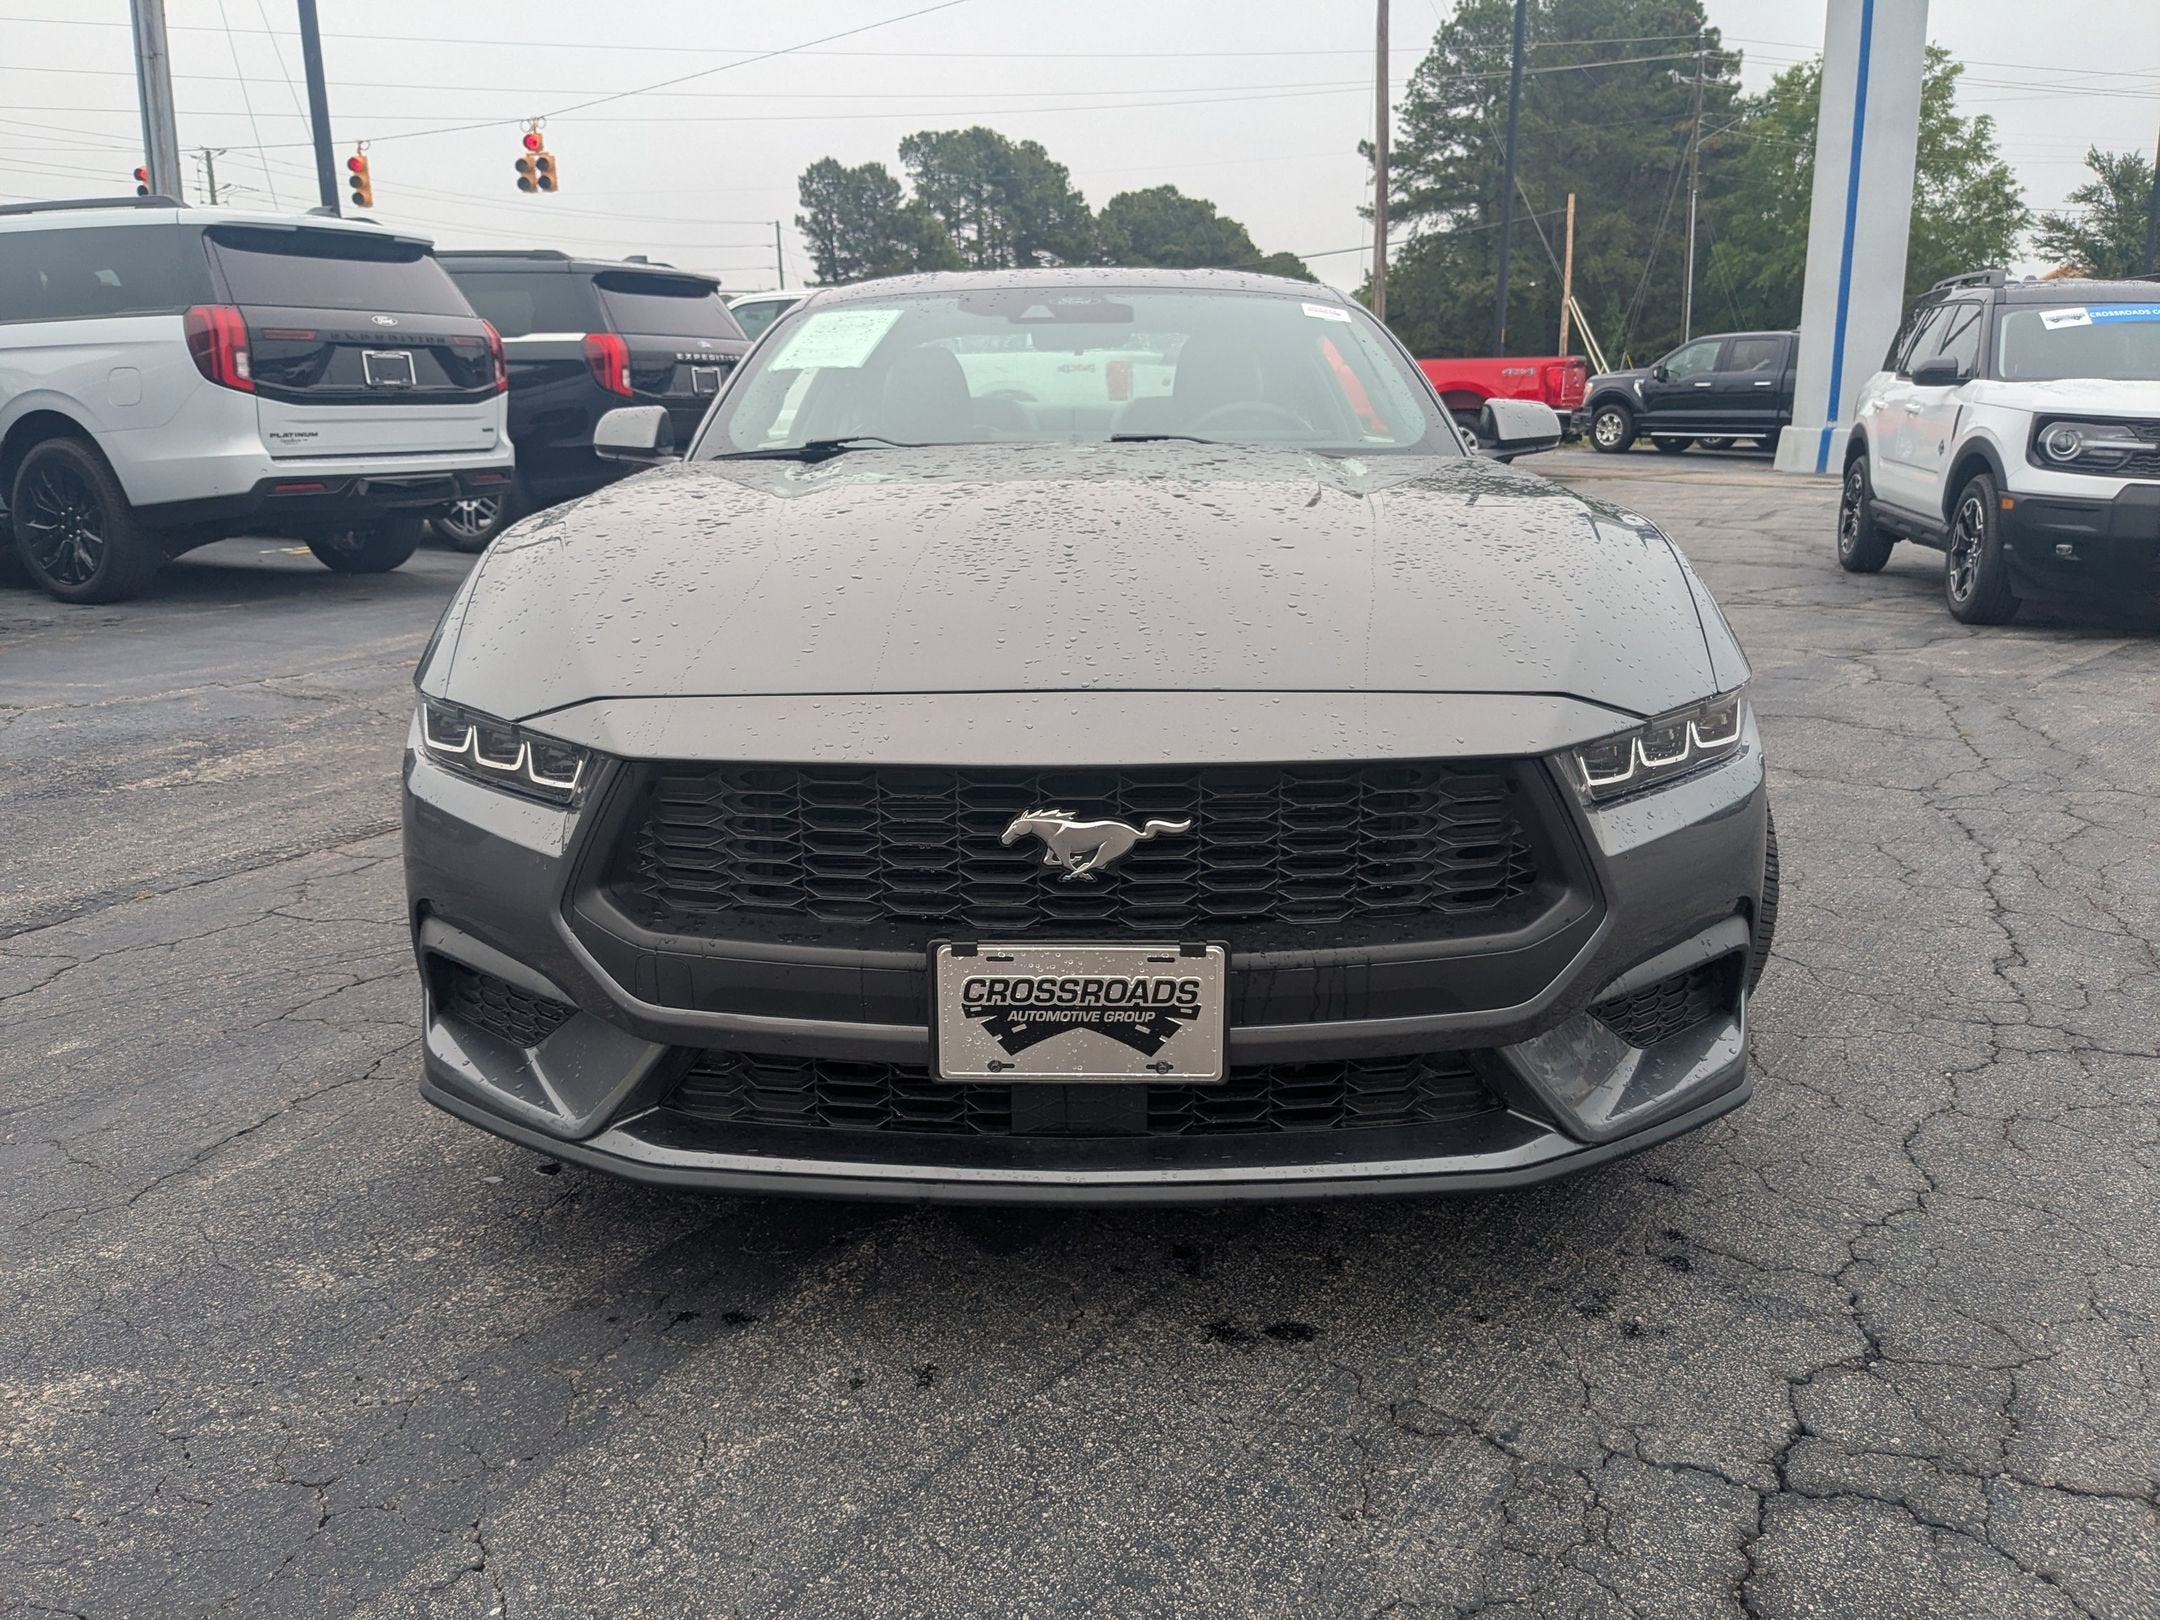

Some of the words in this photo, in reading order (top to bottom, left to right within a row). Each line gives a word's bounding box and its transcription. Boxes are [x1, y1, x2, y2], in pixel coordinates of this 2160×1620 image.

[2089, 309, 2151, 318] CROSSROADS
[962, 977, 1200, 1005] CROSSROADS
[1007, 1010, 1100, 1023] AUTOMOTIVE
[1104, 1010, 1156, 1023] GROUP
